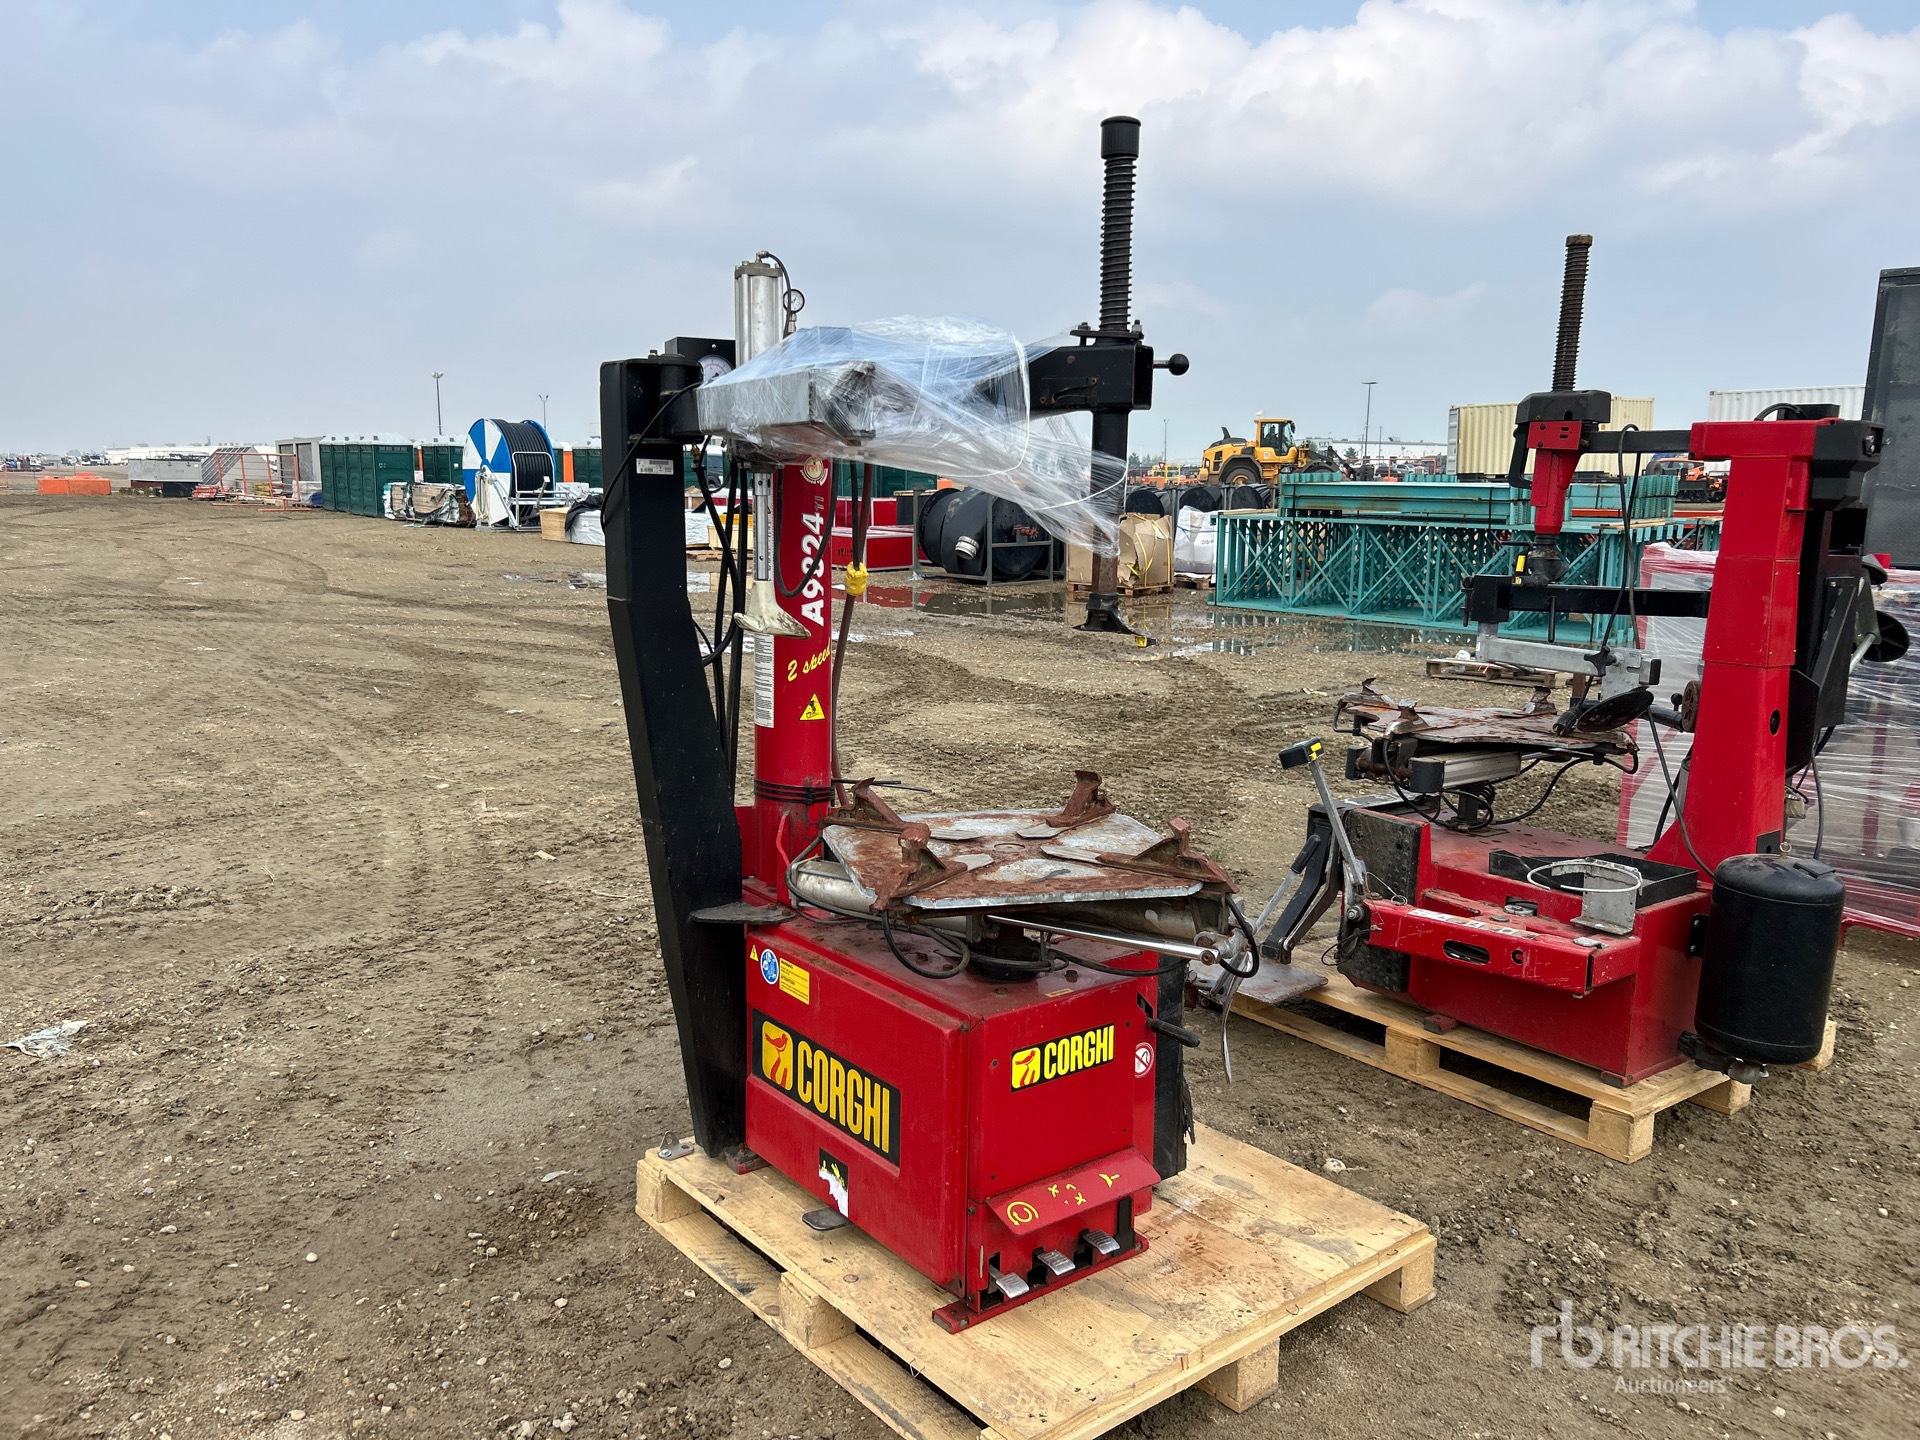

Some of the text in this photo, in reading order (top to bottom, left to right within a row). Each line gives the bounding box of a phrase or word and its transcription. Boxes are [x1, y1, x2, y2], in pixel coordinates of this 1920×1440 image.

[787, 637, 831, 682] 2 speed
[1043, 1025, 1115, 1080] CORGHI
[797, 1040, 890, 1153] CORGHI
